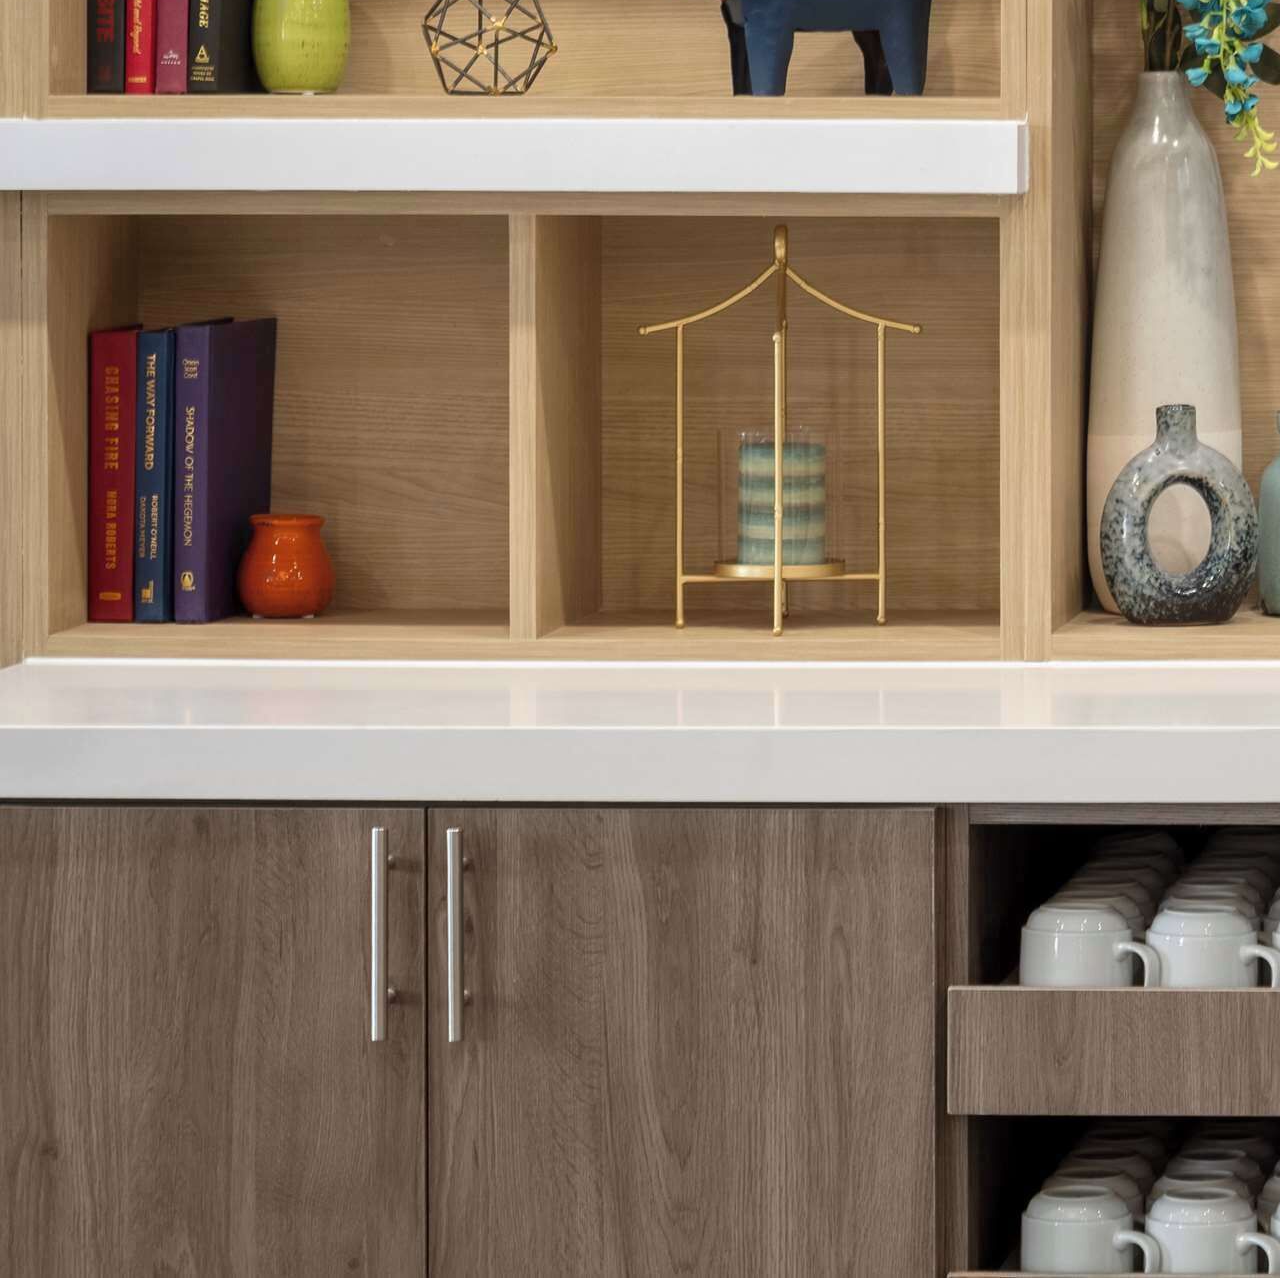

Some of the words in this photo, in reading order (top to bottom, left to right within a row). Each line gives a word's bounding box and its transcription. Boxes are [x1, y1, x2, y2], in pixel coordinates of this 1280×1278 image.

[146, 353, 158, 378] THE
[103, 365, 120, 431] CHASING
[145, 379, 157, 407] WAY
[144, 408, 156, 472] FORWARD
[184, 406, 197, 453] SHADOW
[103, 436, 119, 471] FIRE
[183, 456, 195, 472] OF
[183, 473, 195, 492] THE
[105, 490, 118, 519] NORA
[149, 494, 160, 527] ROBERT
[182, 495, 194, 547] HEGEMON
[104, 522, 117, 571] ROBERTS
